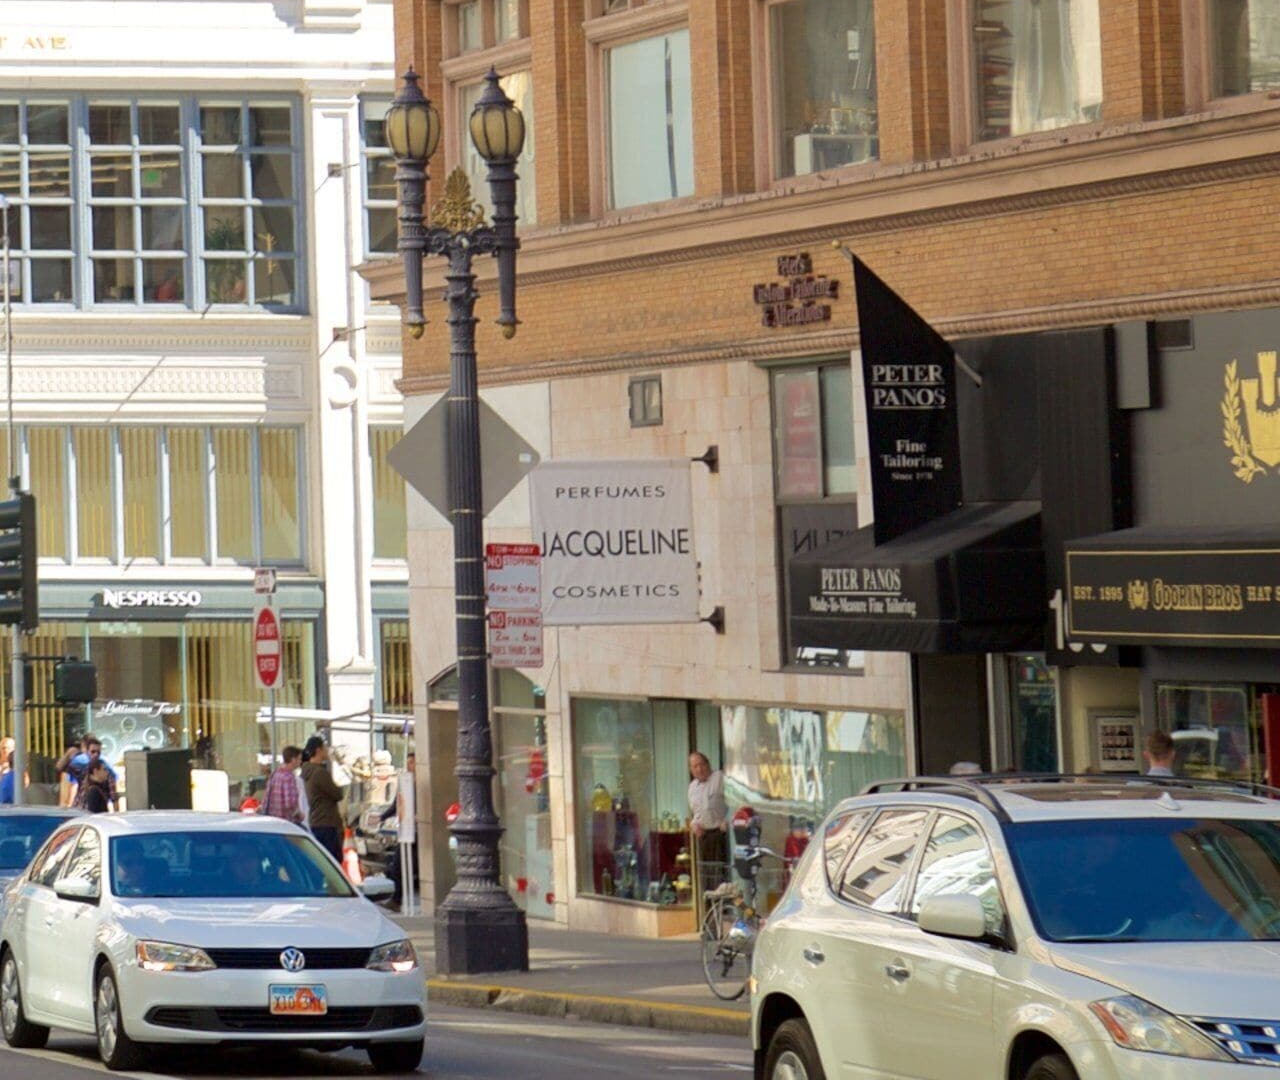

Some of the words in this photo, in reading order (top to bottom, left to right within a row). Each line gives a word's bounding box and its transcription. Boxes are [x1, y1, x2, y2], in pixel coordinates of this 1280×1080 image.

[871, 364, 945, 383] PETER
[872, 388, 947, 406] PANOS
[896, 439, 927, 453] Fine
[882, 454, 944, 471] Tailoring
[555, 485, 666, 500] PERFUMES
[540, 528, 689, 558] JACQUELINE
[821, 568, 859, 591] PETER
[862, 568, 902, 591] PANOS
[103, 587, 202, 609] NESPRESSO
[551, 584, 680, 599] COSMETICS
